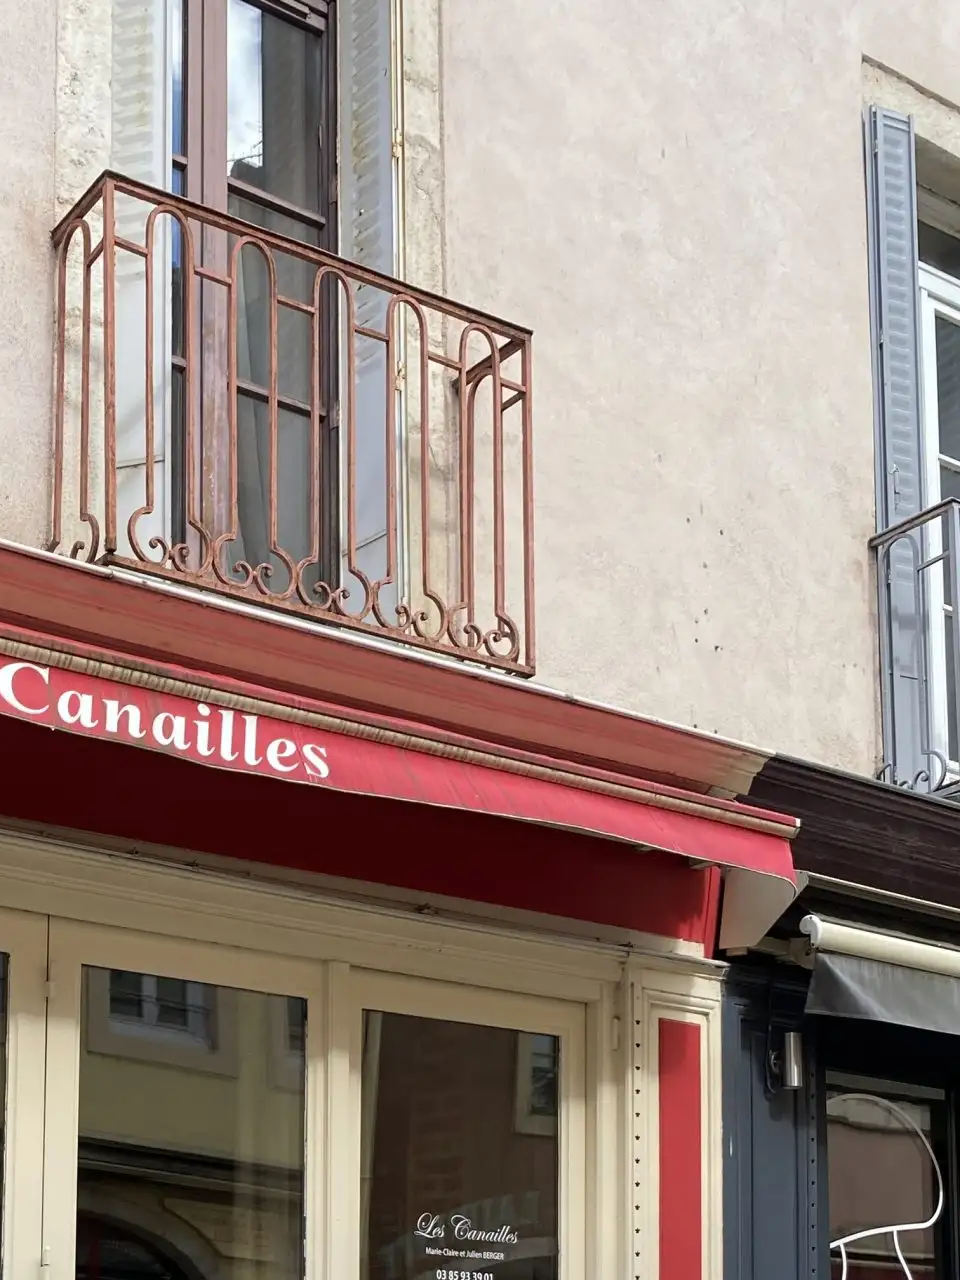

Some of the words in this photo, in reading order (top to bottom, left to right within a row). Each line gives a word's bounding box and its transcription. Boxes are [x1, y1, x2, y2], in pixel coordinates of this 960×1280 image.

[413, 1212, 446, 1239] Les
[450, 1214, 518, 1244] Canailles
[425, 1246, 459, 1257] Marie-Claire
[466, 1250, 483, 1259] Julien
[483, 1251, 505, 1260] BERGER
[436, 1269, 447, 1280] 03
[448, 1270, 459, 1280] 85
